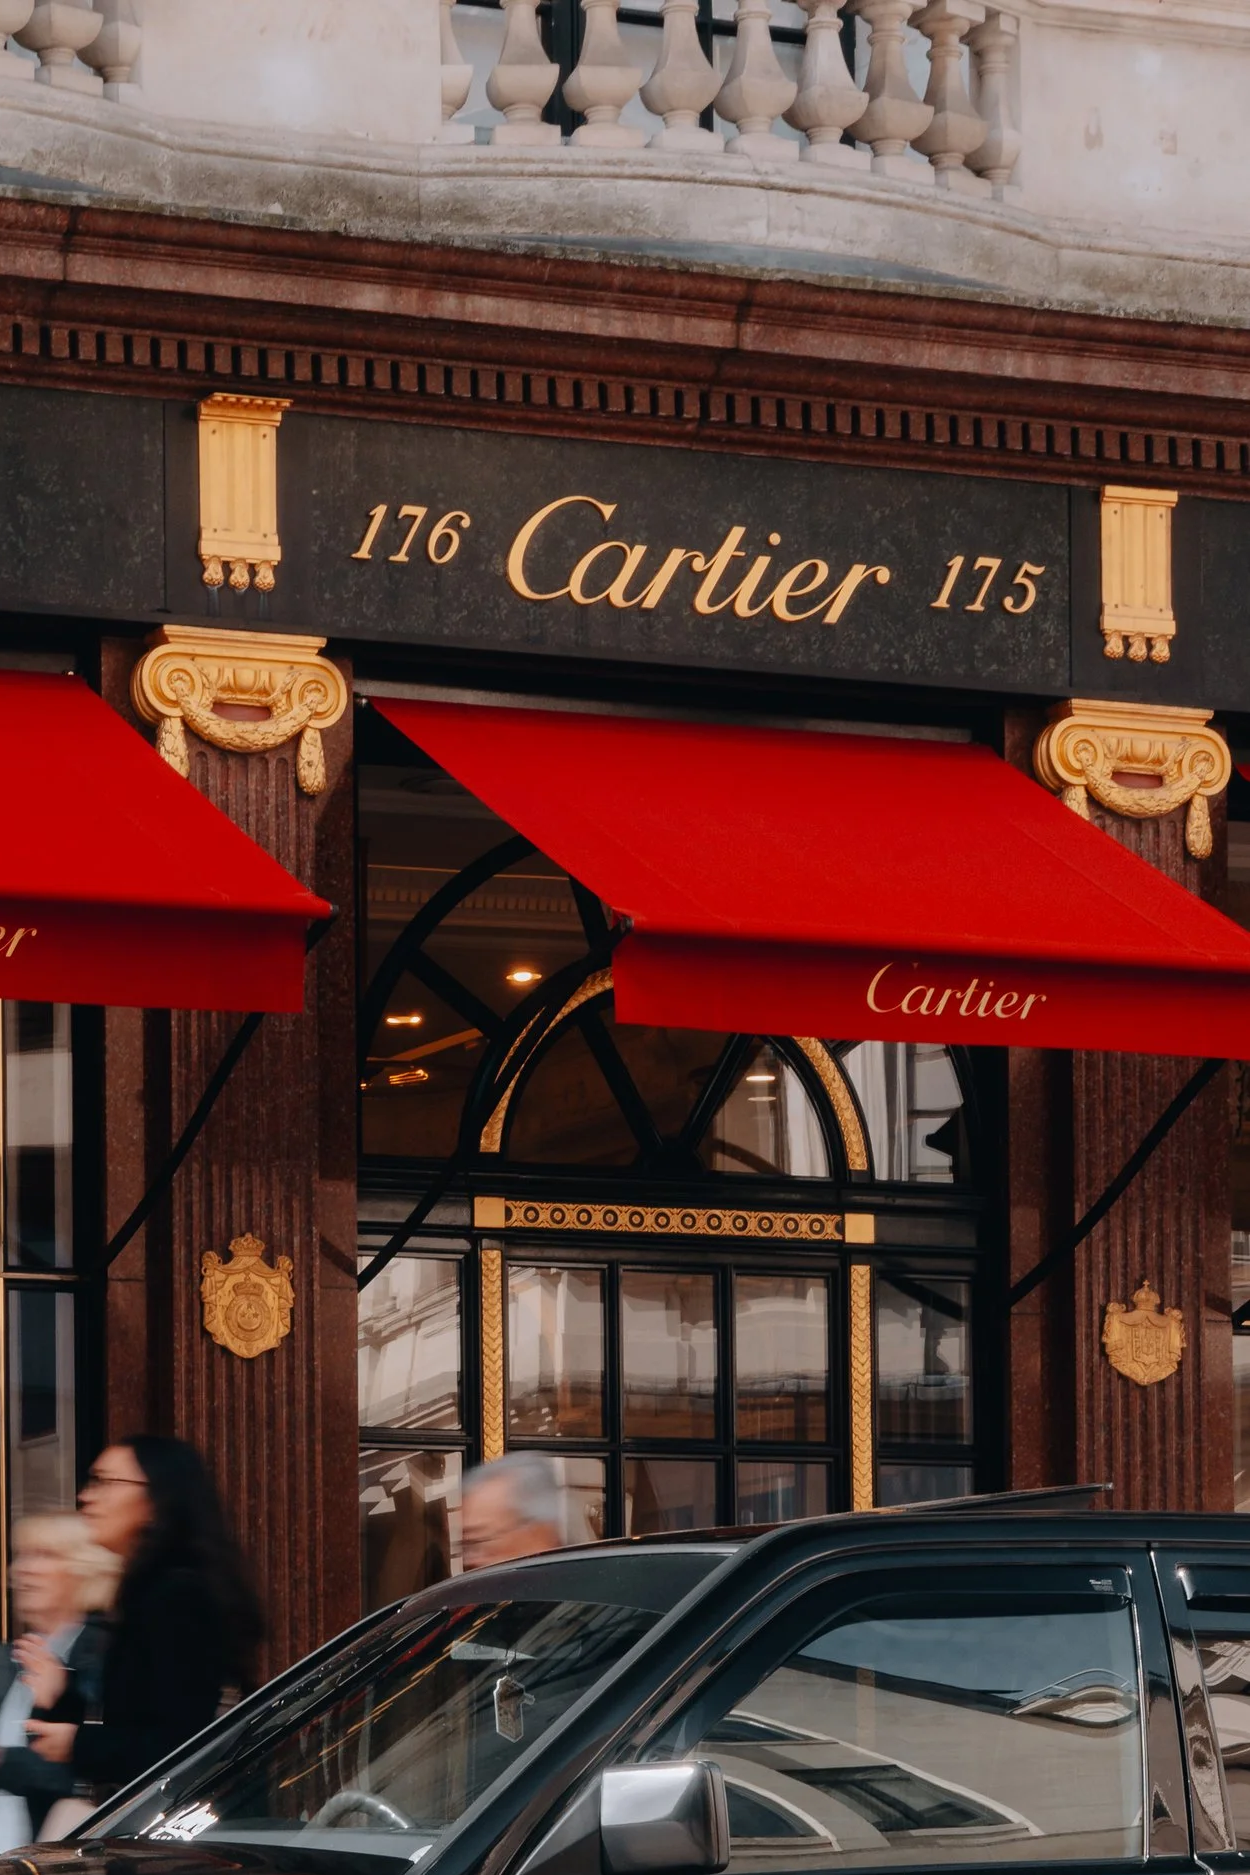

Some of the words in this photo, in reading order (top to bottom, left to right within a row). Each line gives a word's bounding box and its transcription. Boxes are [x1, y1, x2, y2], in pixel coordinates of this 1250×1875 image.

[350, 503, 471, 565] 176
[505, 495, 891, 625] Cartier
[929, 554, 1047, 615] 175
[866, 961, 1047, 1021] Cartier
